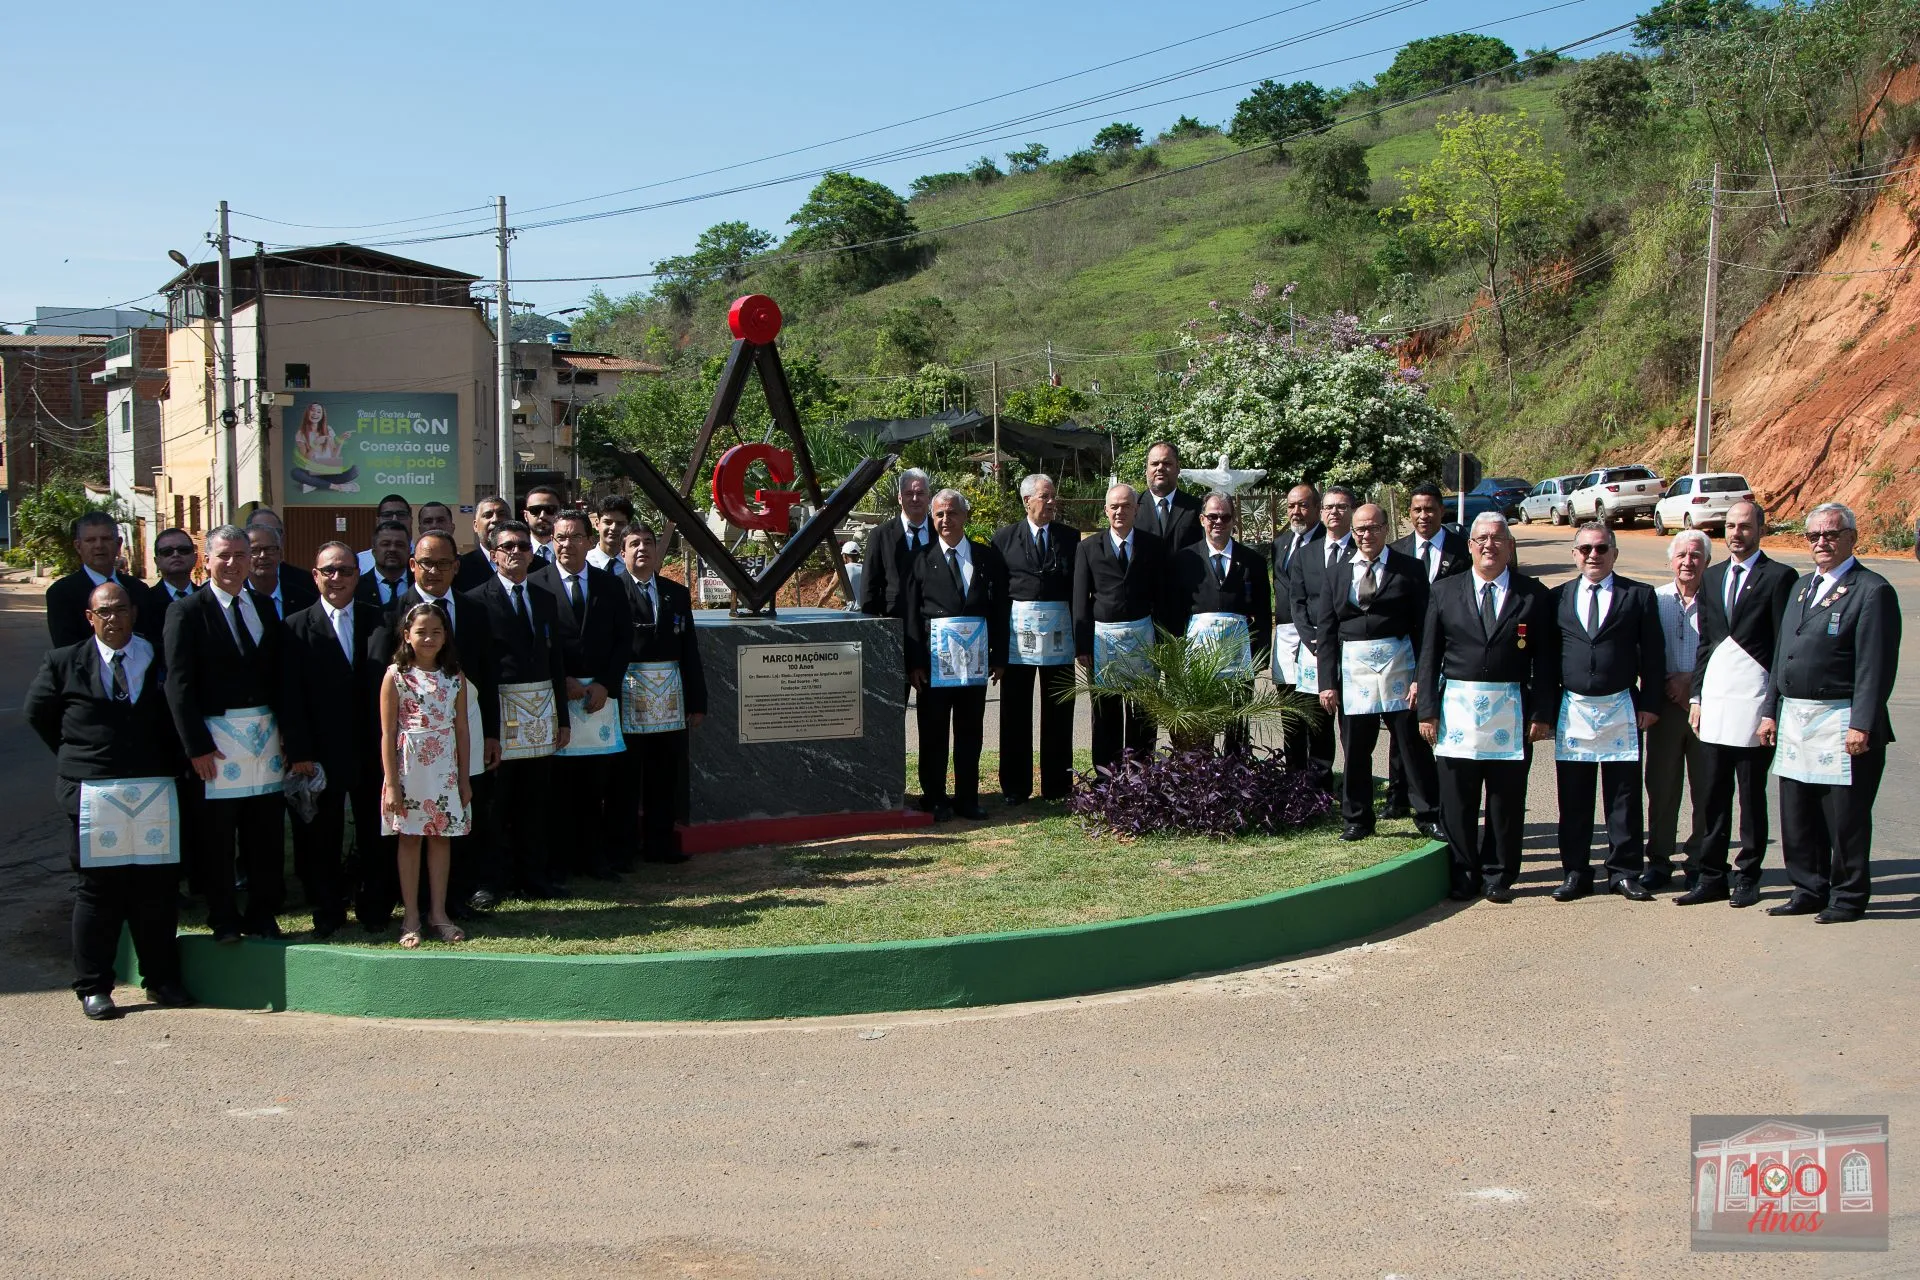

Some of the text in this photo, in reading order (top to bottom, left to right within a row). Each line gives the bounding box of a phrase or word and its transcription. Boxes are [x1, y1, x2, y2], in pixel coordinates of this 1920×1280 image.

[358, 409, 421, 419] Raul Soares tem
[357, 418, 449, 435] FIBRON
[360, 441, 450, 454] Conexão que
[406, 456, 447, 470] pode
[375, 472, 435, 485] Confiar!
[712, 443, 800, 535] G
[762, 652, 839, 663] MARCO MAÇÔNICO
